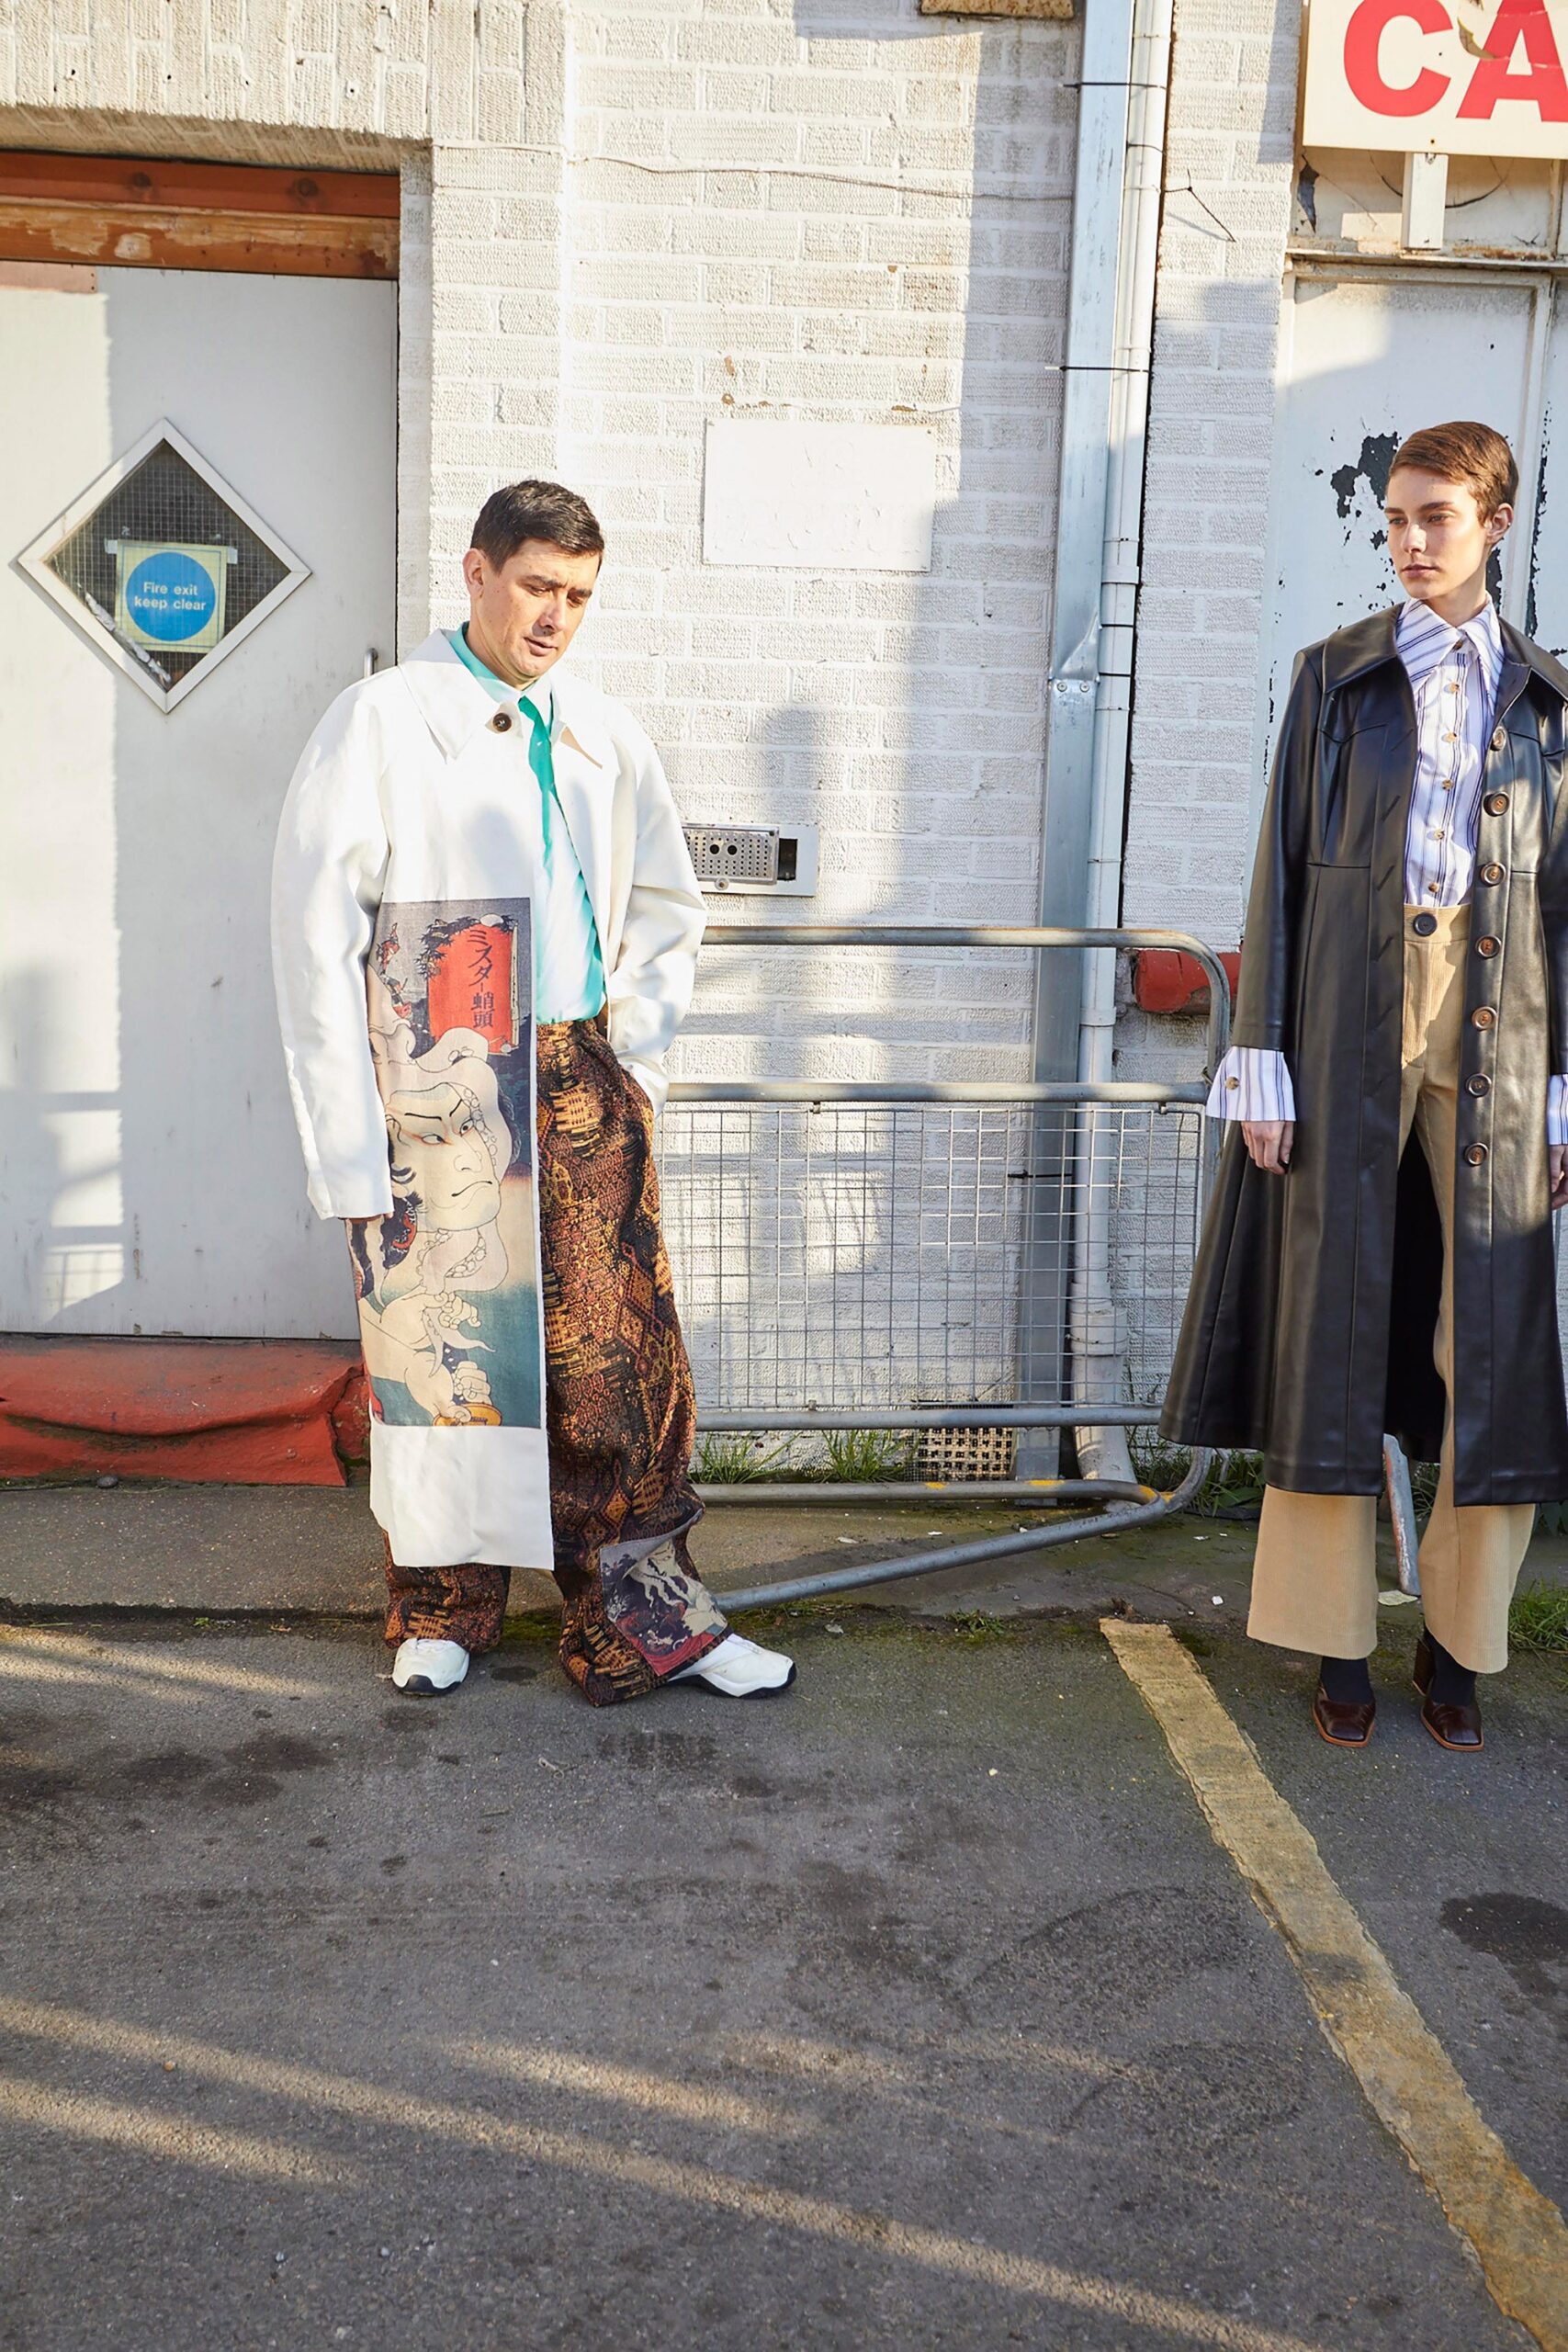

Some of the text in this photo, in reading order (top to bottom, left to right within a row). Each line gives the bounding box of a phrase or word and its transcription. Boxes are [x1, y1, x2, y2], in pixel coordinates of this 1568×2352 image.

[1344, 0, 1568, 122] CA
[143, 582, 197, 596] Fire exit
[134, 595, 207, 610] keep clear
